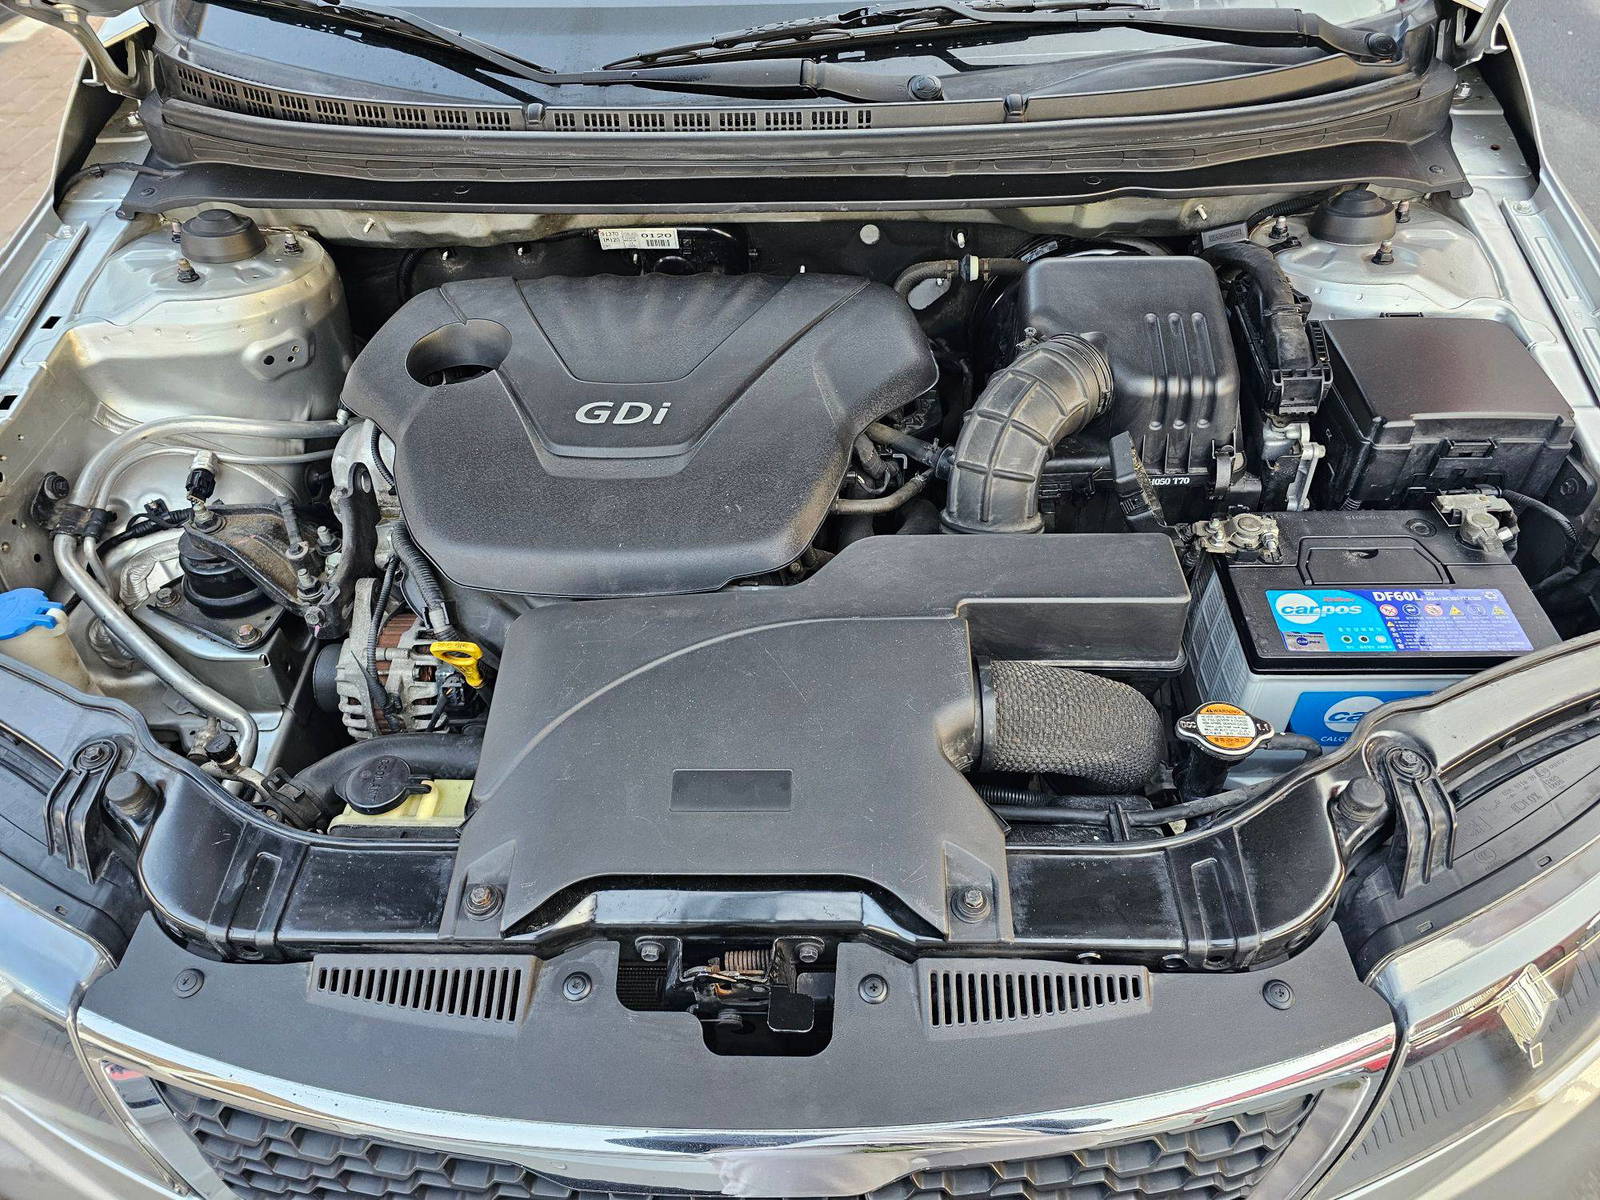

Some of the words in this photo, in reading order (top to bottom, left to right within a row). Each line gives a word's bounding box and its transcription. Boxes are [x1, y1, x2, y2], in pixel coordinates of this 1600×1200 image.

[575, 401, 672, 425] GDi
[1372, 591, 1424, 602] DF60L
[1279, 603, 1363, 617] carpos
